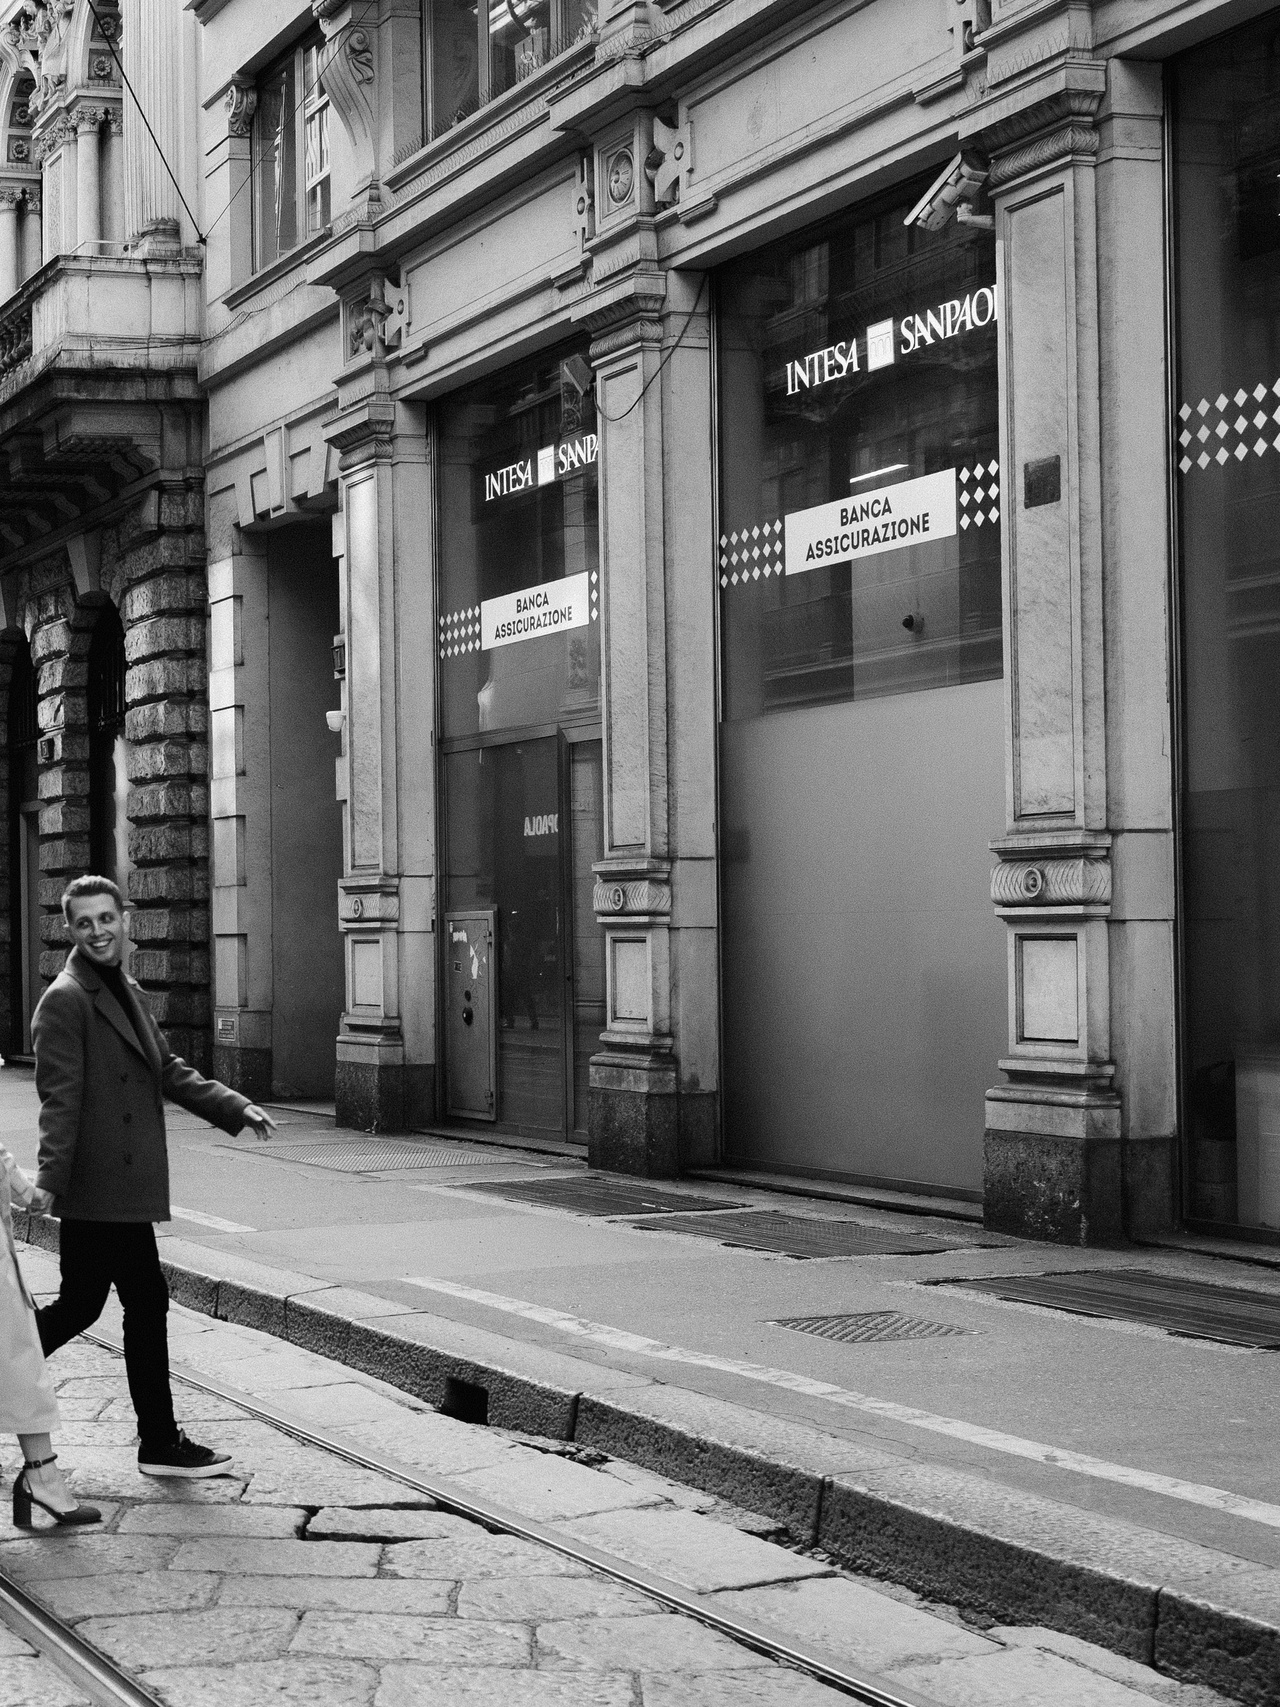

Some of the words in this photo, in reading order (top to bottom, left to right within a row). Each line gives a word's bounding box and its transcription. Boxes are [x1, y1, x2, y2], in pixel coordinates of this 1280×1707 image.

[785, 337, 861, 396] INTESA
[484, 458, 534, 502] INTESA
[840, 496, 893, 527] BANCA
[805, 512, 931, 562] ASSICURAZIONE
[516, 590, 550, 615] BANCA
[494, 605, 573, 640] ASSICURAZIONE
